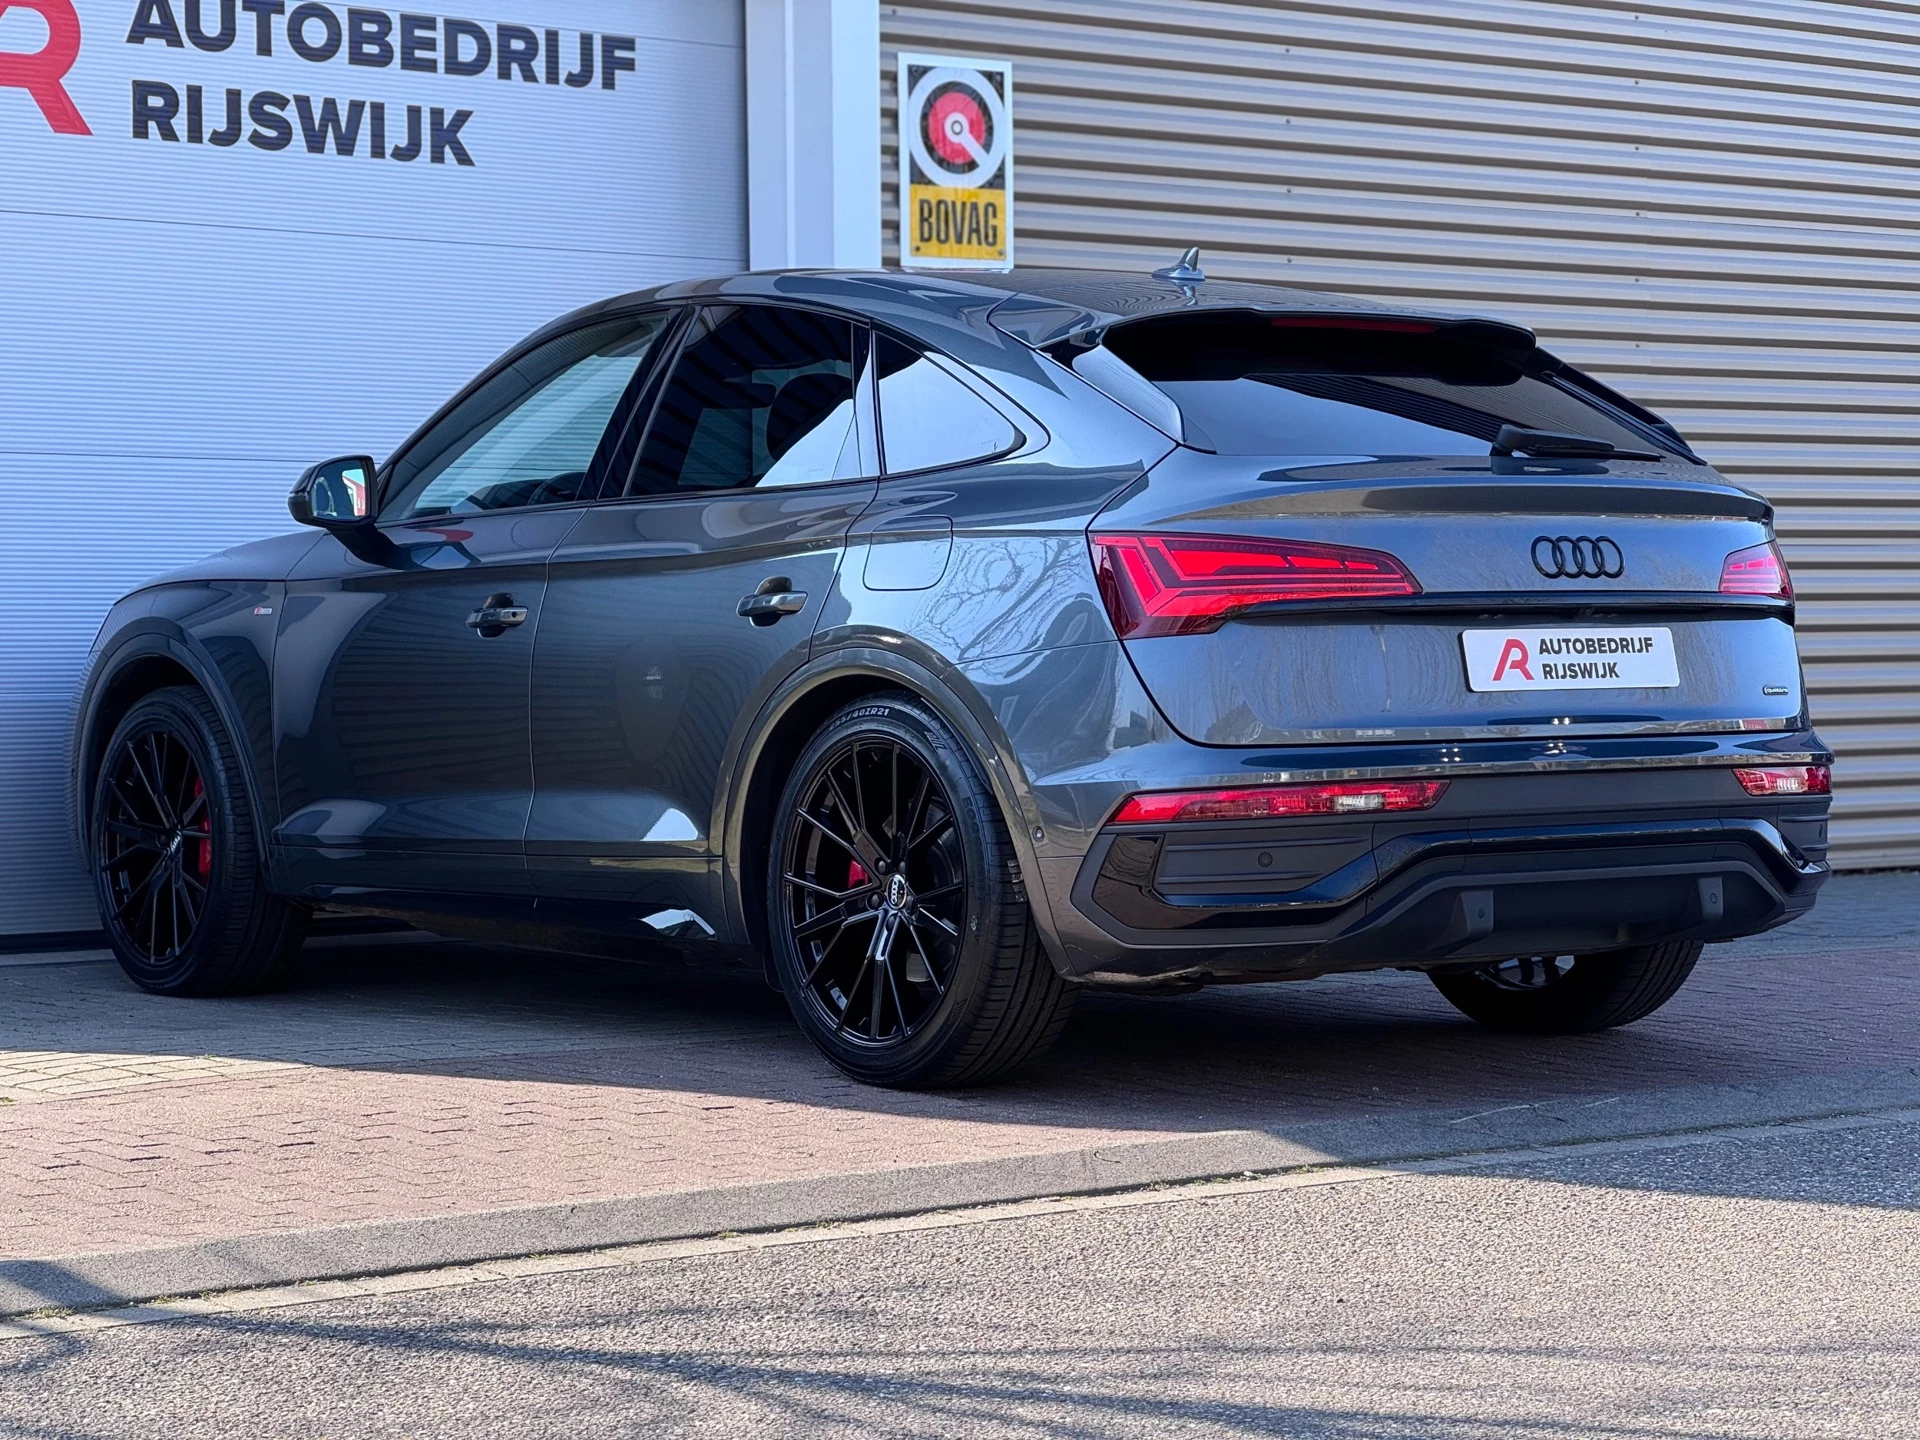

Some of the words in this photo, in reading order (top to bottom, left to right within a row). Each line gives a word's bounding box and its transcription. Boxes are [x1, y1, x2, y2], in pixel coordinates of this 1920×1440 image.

[126, 0, 636, 90] AUTOBEDRIJF
[131, 79, 476, 167] RIJSWIJK
[918, 198, 998, 247] BOVAG
[1538, 637, 1654, 655] AUTOBEDRIJF
[1541, 662, 1620, 680] RIJSWIJK
